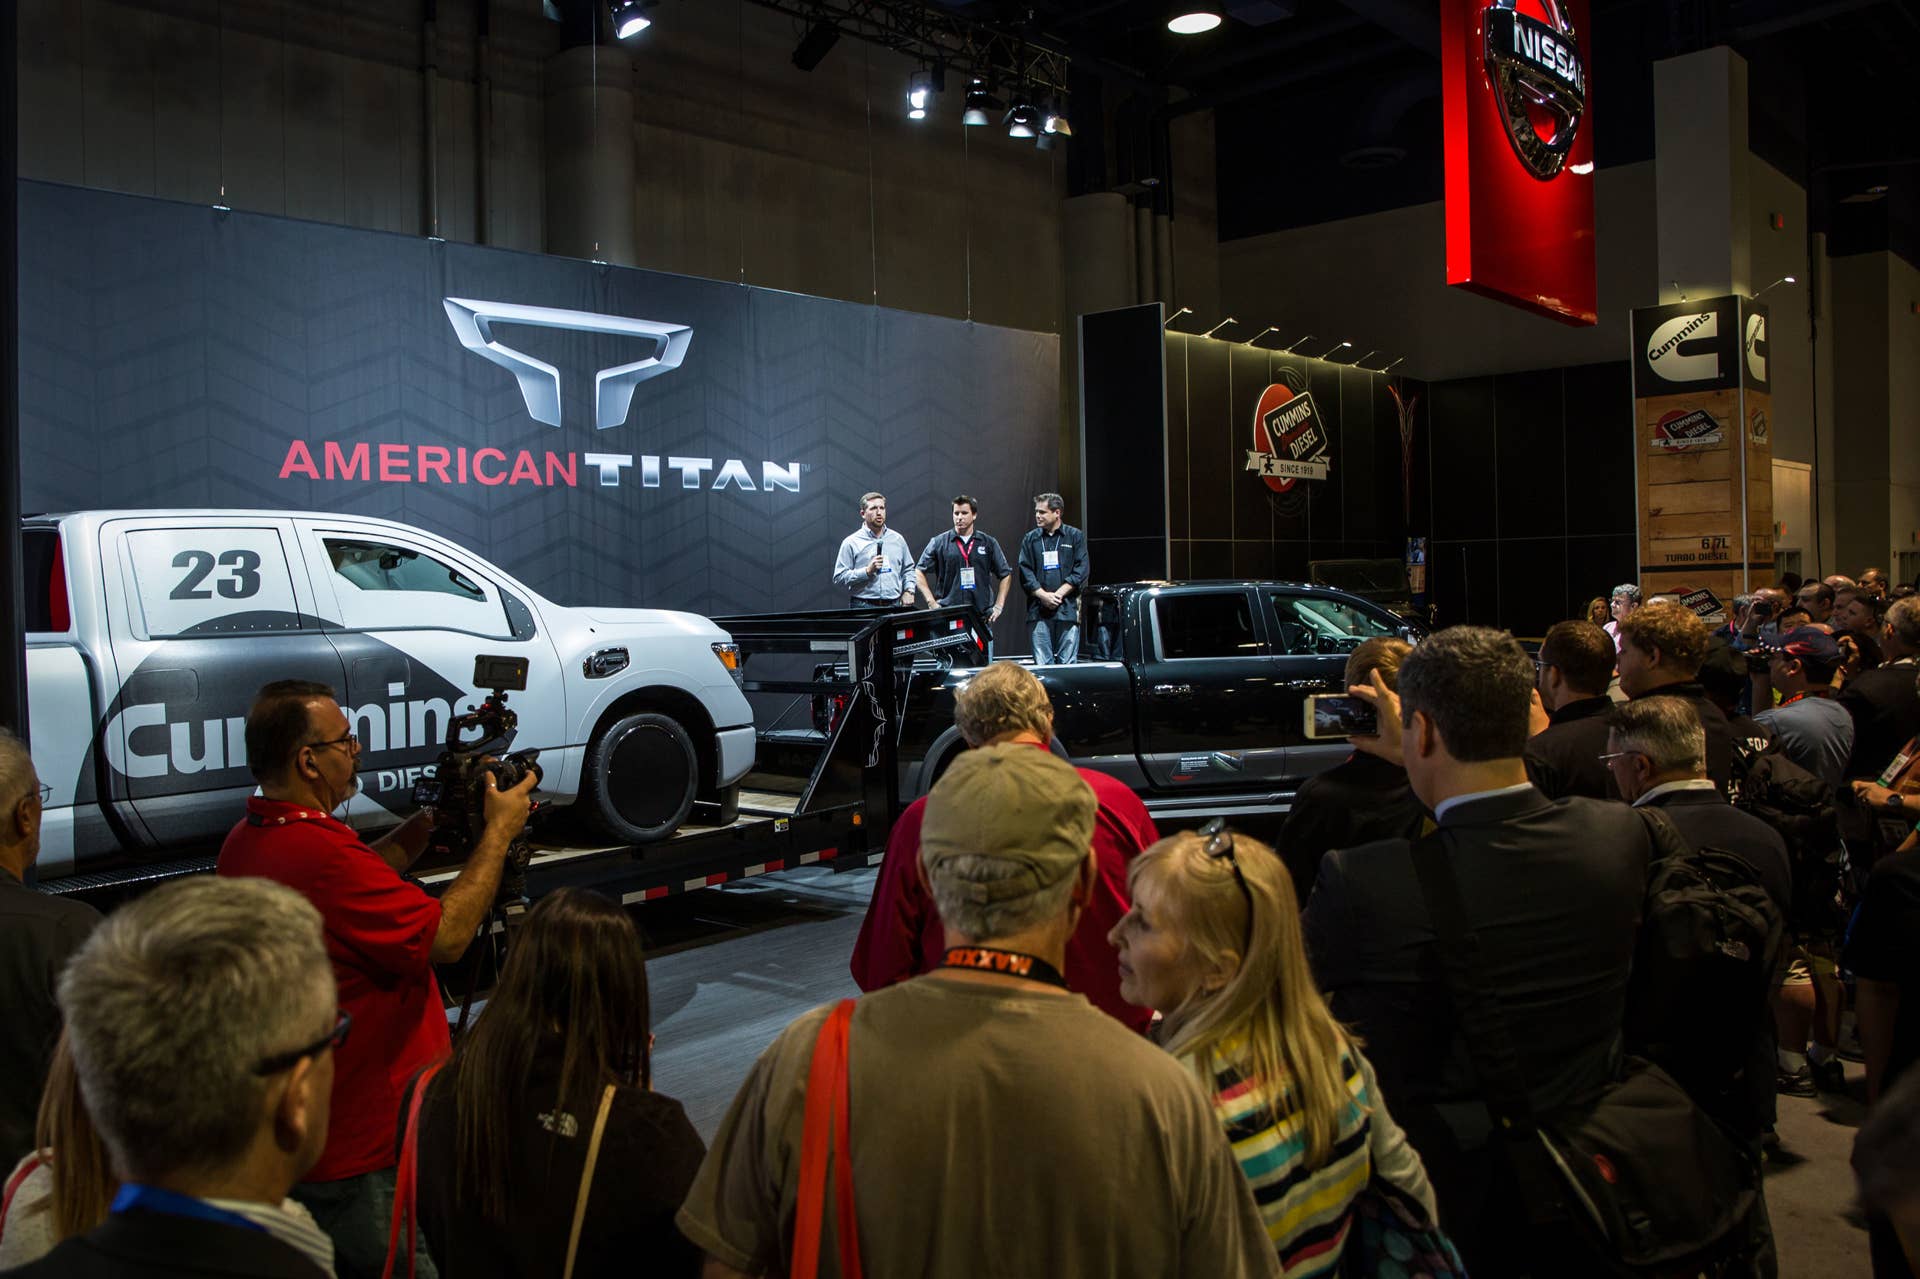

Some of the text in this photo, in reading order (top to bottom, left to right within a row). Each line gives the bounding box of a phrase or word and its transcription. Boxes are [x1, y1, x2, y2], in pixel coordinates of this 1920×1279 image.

[1648, 312, 1711, 361] Cummins
[1272, 401, 1311, 437] CUMMINS
[1670, 412, 1705, 431] CUMMINS
[1684, 422, 1711, 438] DIESEL
[1289, 428, 1318, 460] DIESEL
[278, 440, 577, 487] AMERICAN
[585, 452, 800, 491] TITAN
[1280, 463, 1314, 475] SINCE 1919
[1664, 551, 1729, 563] TURBO DIESEL
[169, 549, 261, 600] 23
[1680, 592, 1710, 607] MMINS
[1694, 601, 1716, 614] IESEL
[103, 681, 485, 778] Cumin
[377, 764, 439, 792] DIES
